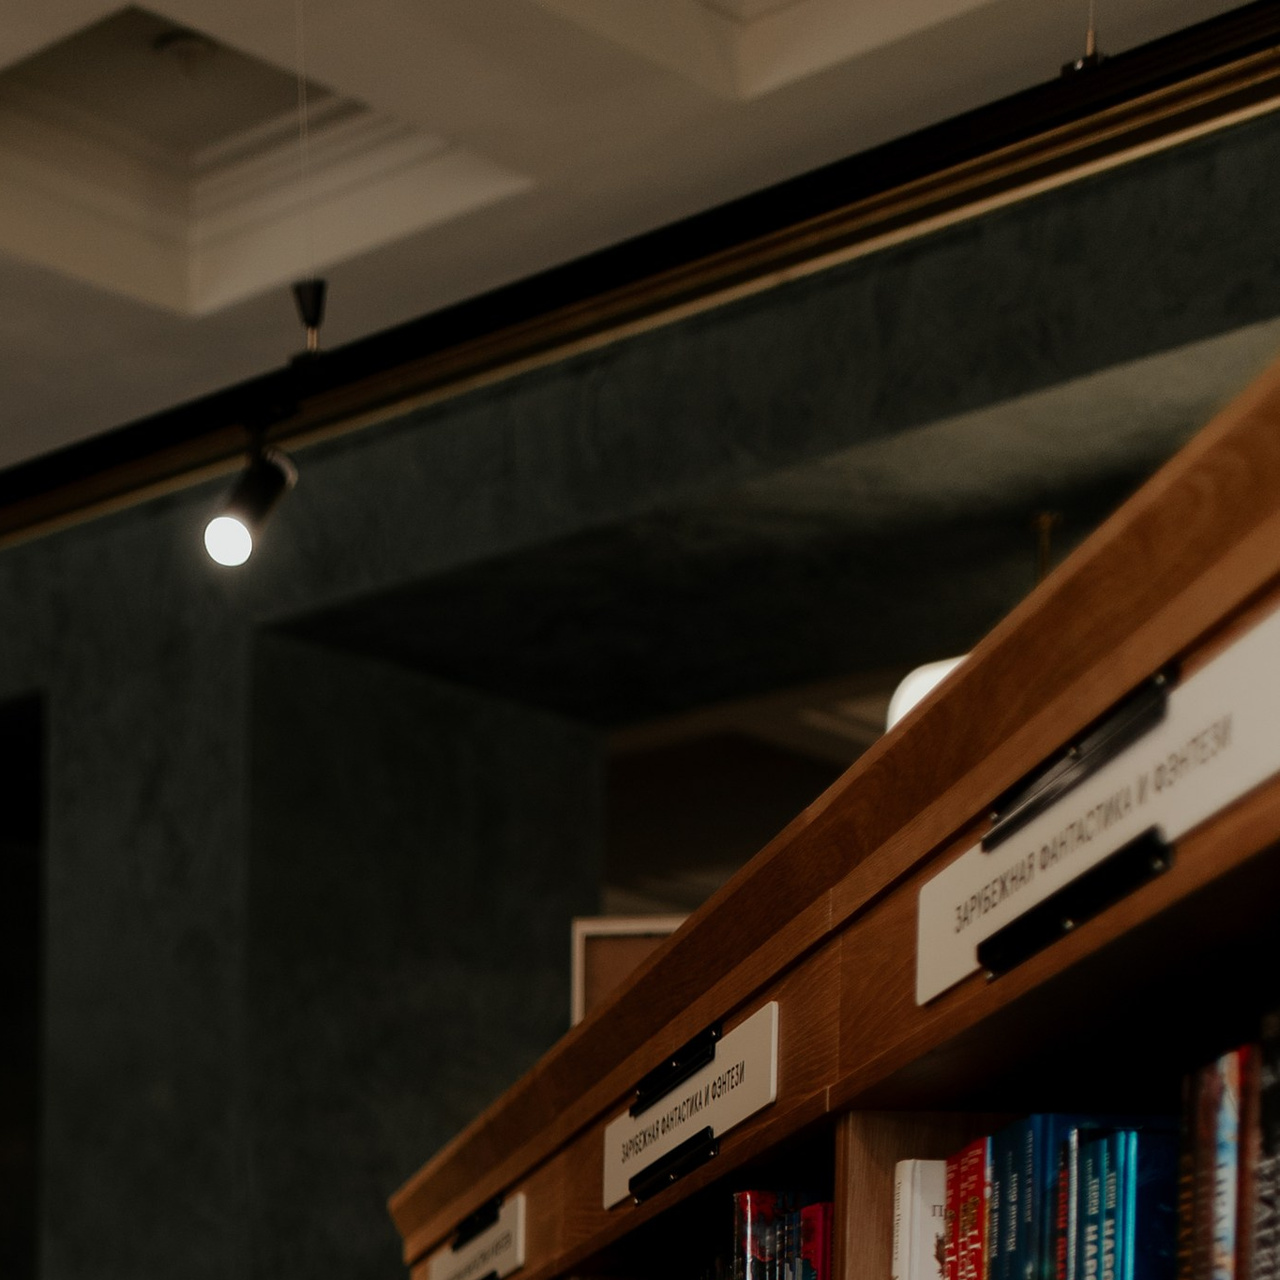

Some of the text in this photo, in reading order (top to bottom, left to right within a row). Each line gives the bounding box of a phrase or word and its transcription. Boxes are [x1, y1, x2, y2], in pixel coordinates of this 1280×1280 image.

[955, 714, 1234, 933] ЗАРУБЕЖНАЯ ФАНТАСТИКА И ФЭНТЕЗИ
[621, 1123, 660, 1163] ЗАРУБЕЖНАЯ
[661, 1090, 703, 1142] ФАНТАСТИКА
[711, 1060, 746, 1103] ФЭНТЕЗИ
